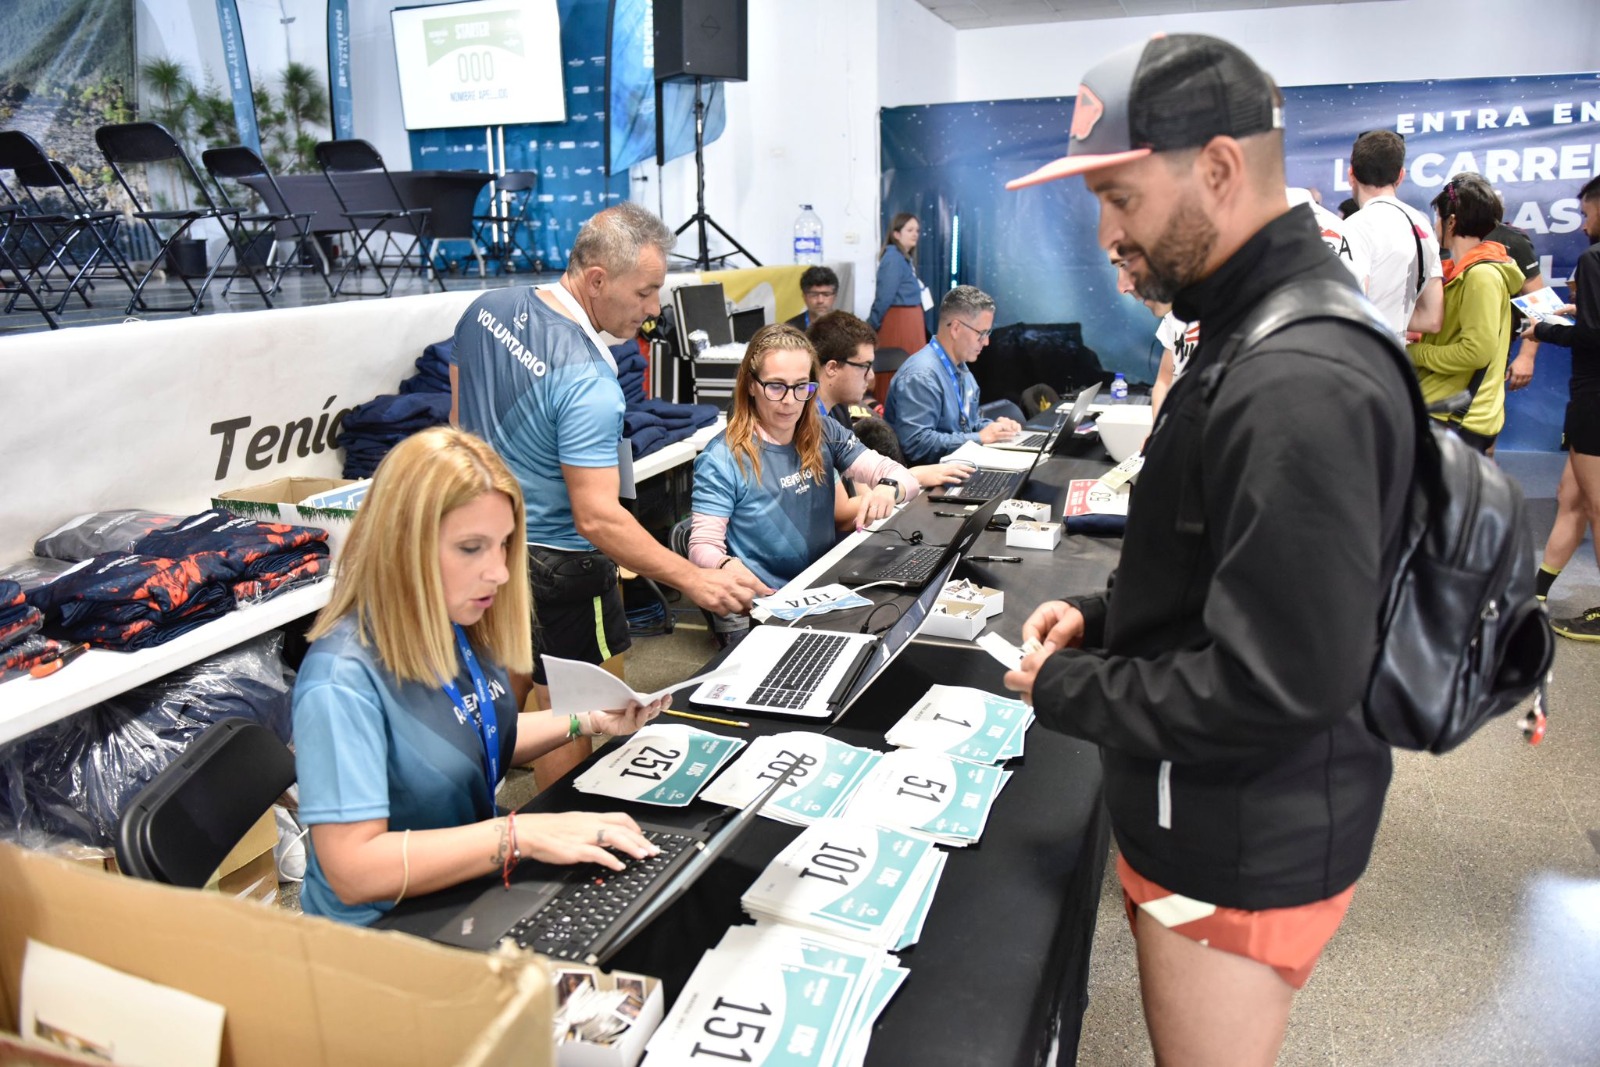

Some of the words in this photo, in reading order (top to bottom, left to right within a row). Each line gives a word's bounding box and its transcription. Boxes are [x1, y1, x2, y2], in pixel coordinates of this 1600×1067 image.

[457, 51, 494, 83] 000
[1397, 105, 1530, 134] ENTRA
[1410, 143, 1600, 188] CARRE
[477, 308, 547, 377] VOLUNTARIO
[933, 713, 971, 728] 1
[619, 745, 681, 781] 251
[686, 761, 708, 777] KIDS
[896, 775, 948, 803] 51
[798, 842, 867, 886] 101
[690, 996, 772, 1063] 151
